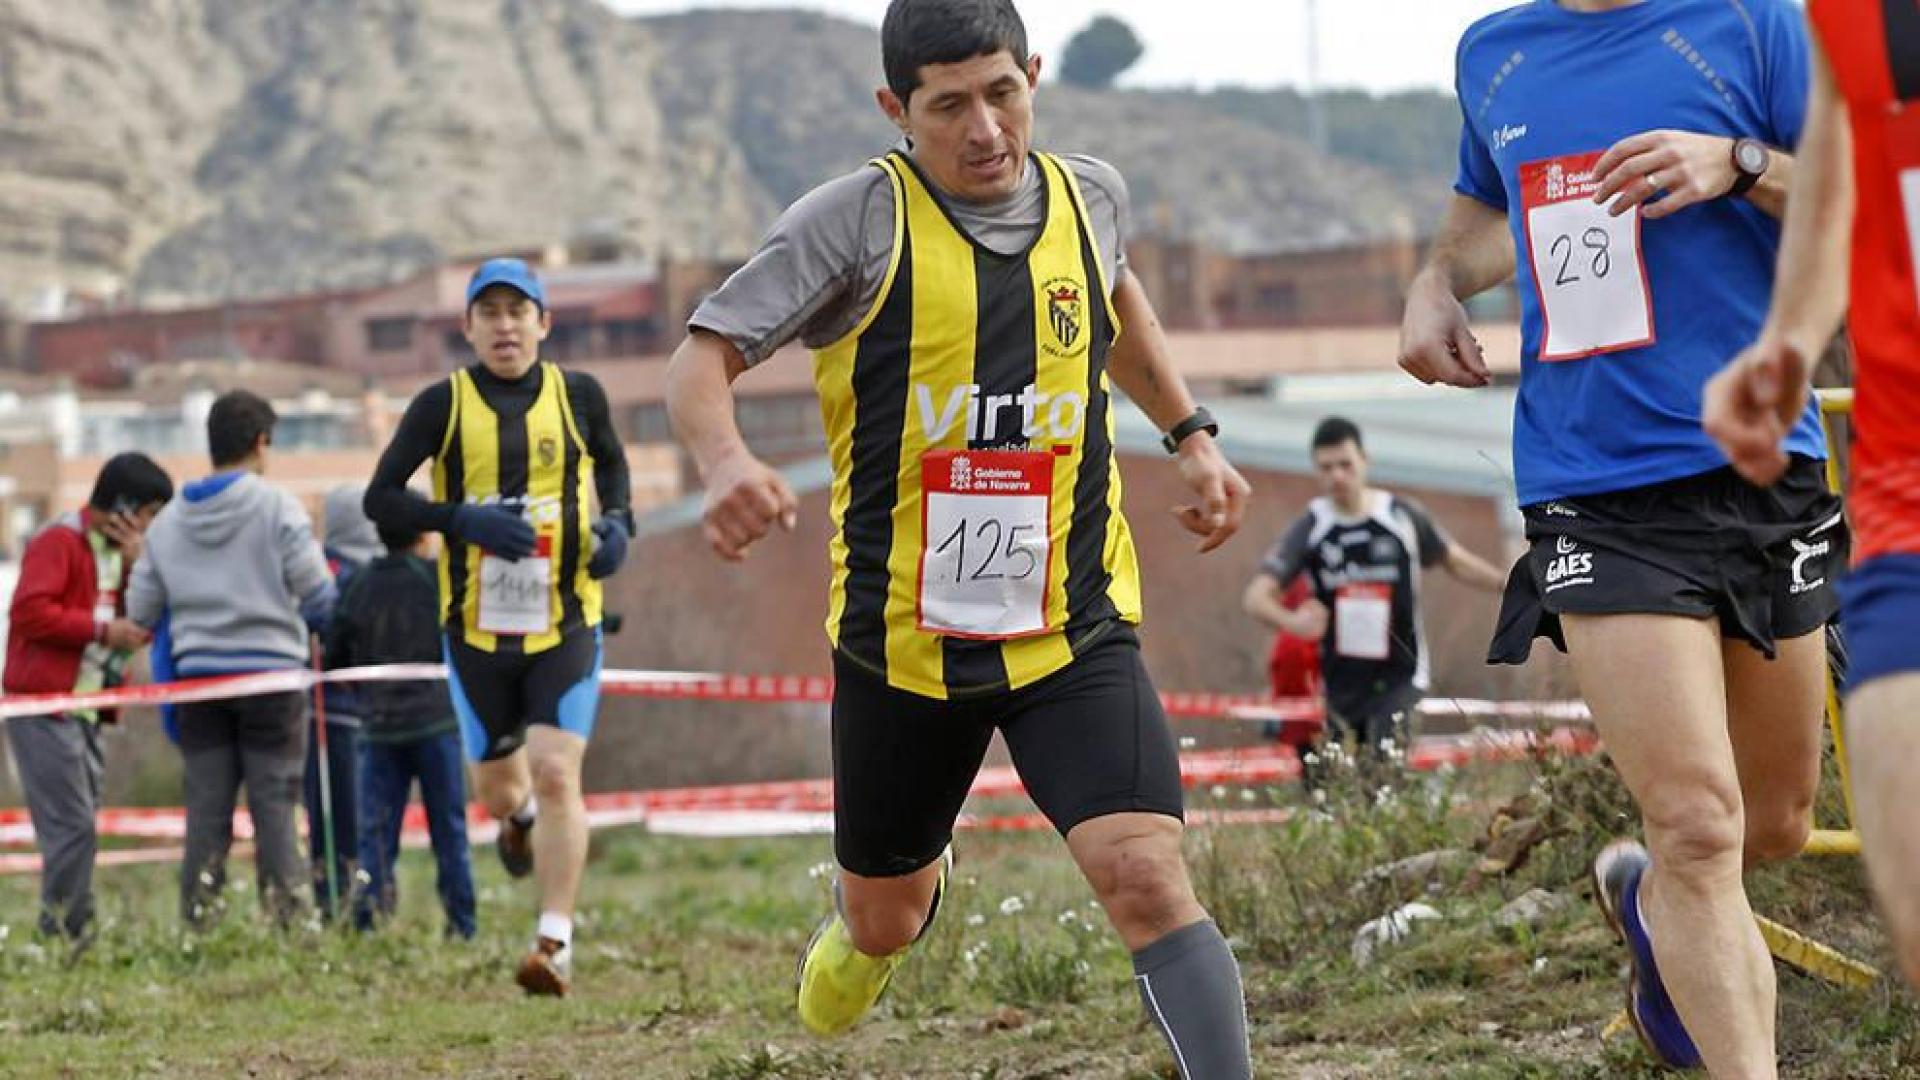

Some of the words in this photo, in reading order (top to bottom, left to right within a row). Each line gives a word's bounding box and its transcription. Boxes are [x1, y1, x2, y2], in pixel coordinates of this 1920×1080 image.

[1550, 226, 1610, 286] 28
[914, 383, 1085, 442] Virto
[973, 480, 988, 490] de
[990, 479, 1031, 491] Navarra
[974, 467, 1023, 479] Gobierno
[936, 518, 1036, 584] 125
[1545, 552, 1593, 583] GAES
